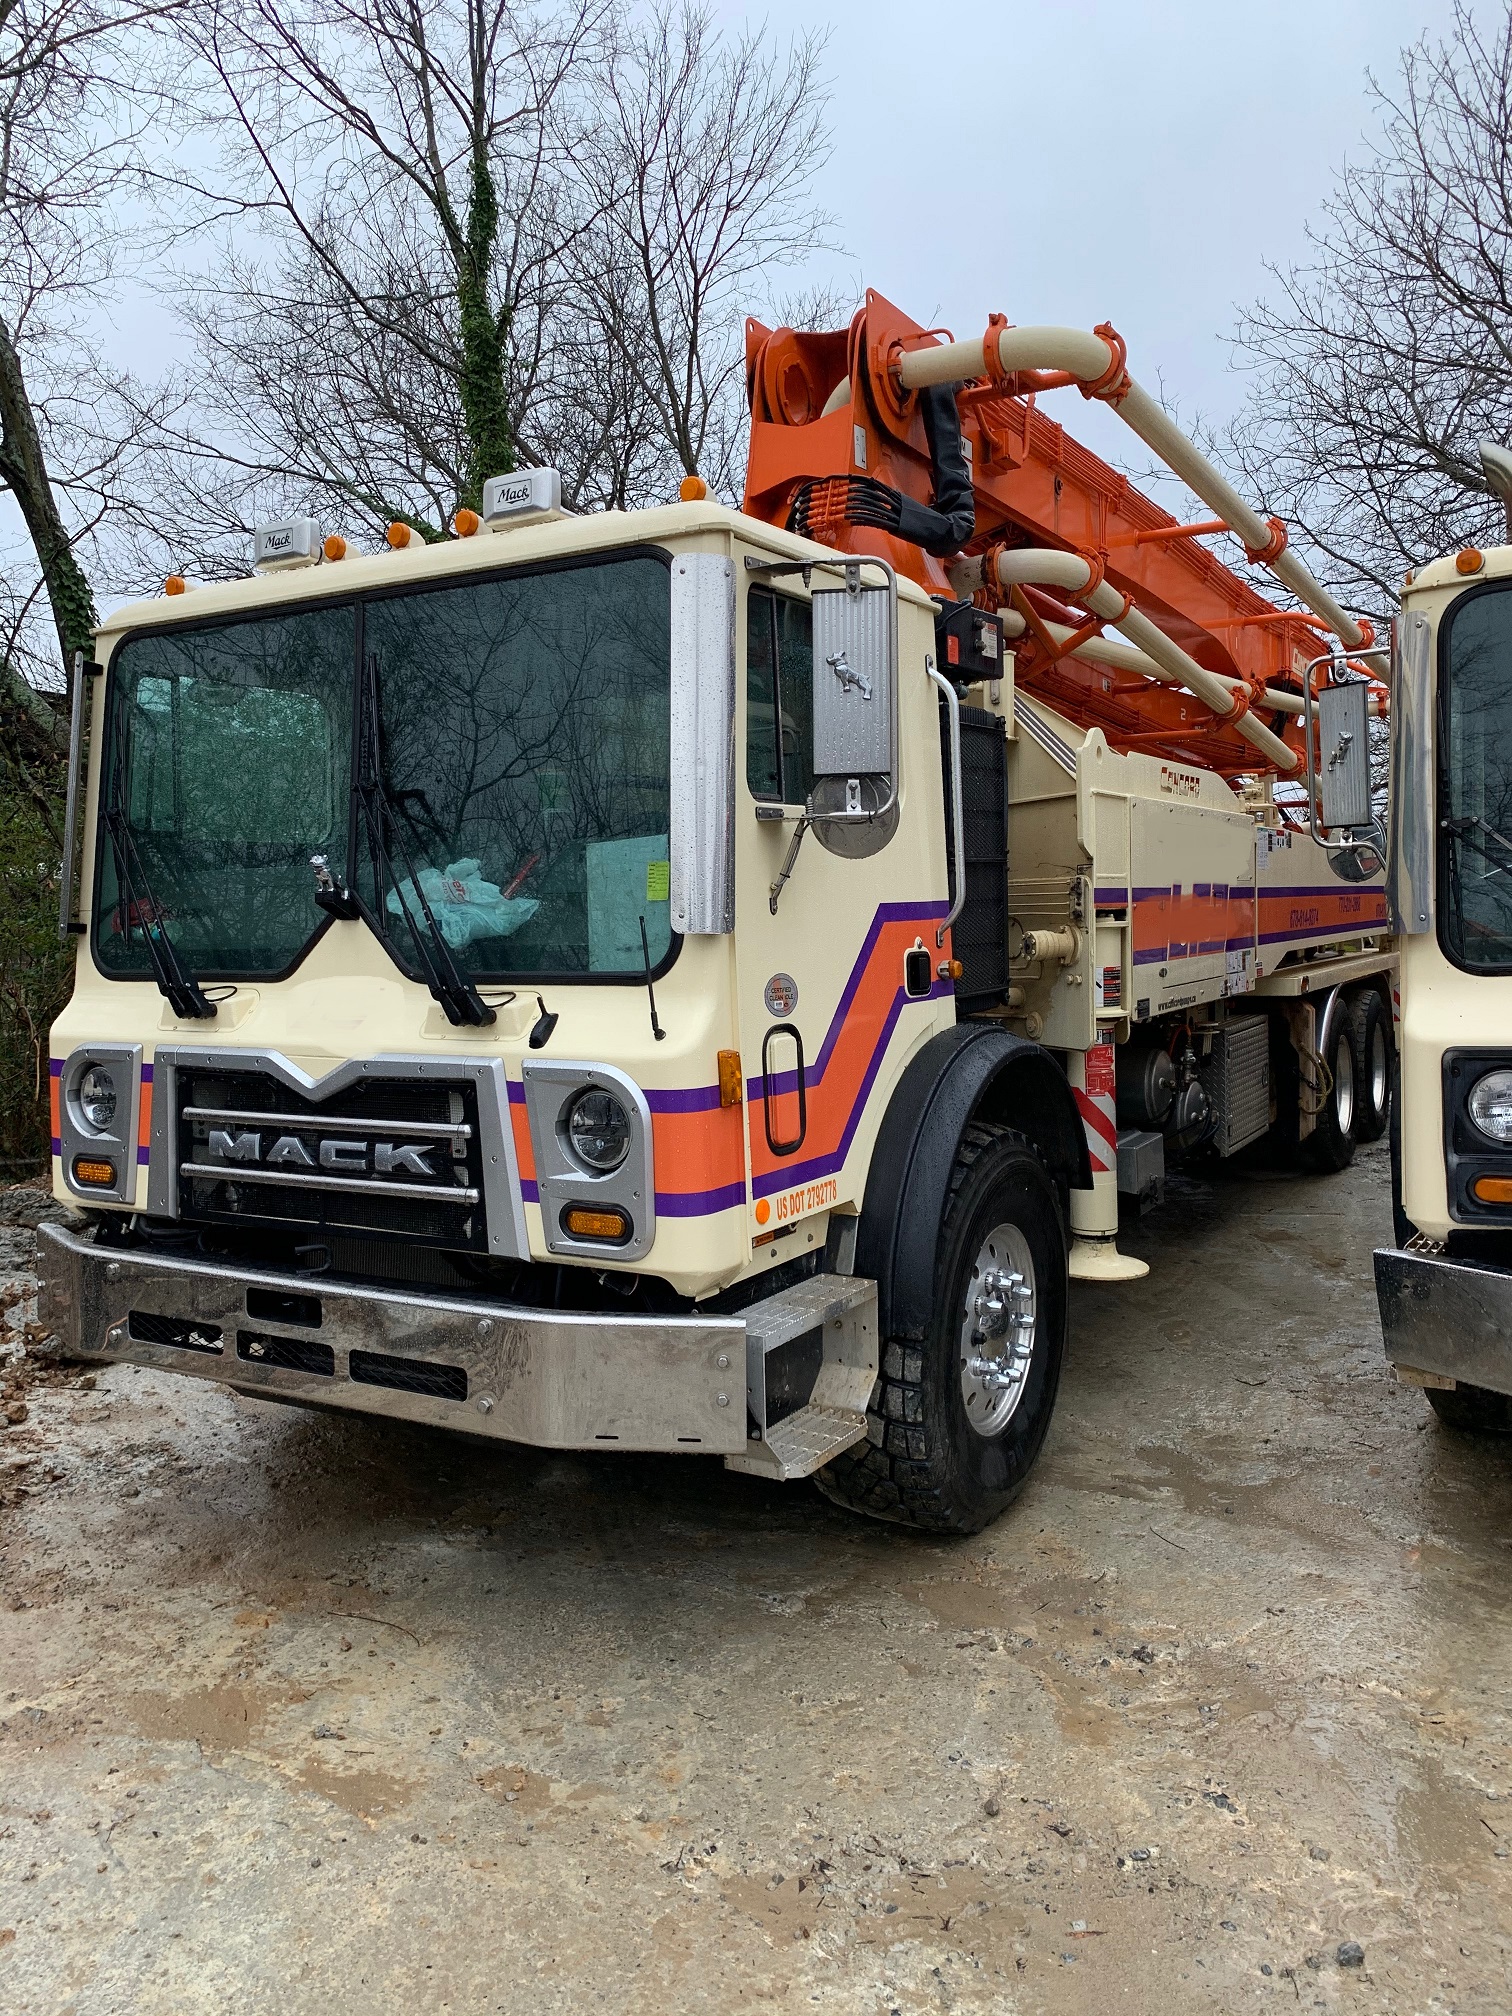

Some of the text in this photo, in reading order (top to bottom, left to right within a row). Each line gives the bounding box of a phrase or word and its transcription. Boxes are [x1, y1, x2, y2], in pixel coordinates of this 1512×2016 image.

[496, 484, 530, 504] Mack
[264, 532, 291, 550] Mack
[769, 994, 784, 1002] CLEAN
[208, 1130, 437, 1176] MACK
[776, 1178, 837, 1221] US DOT 2792778
